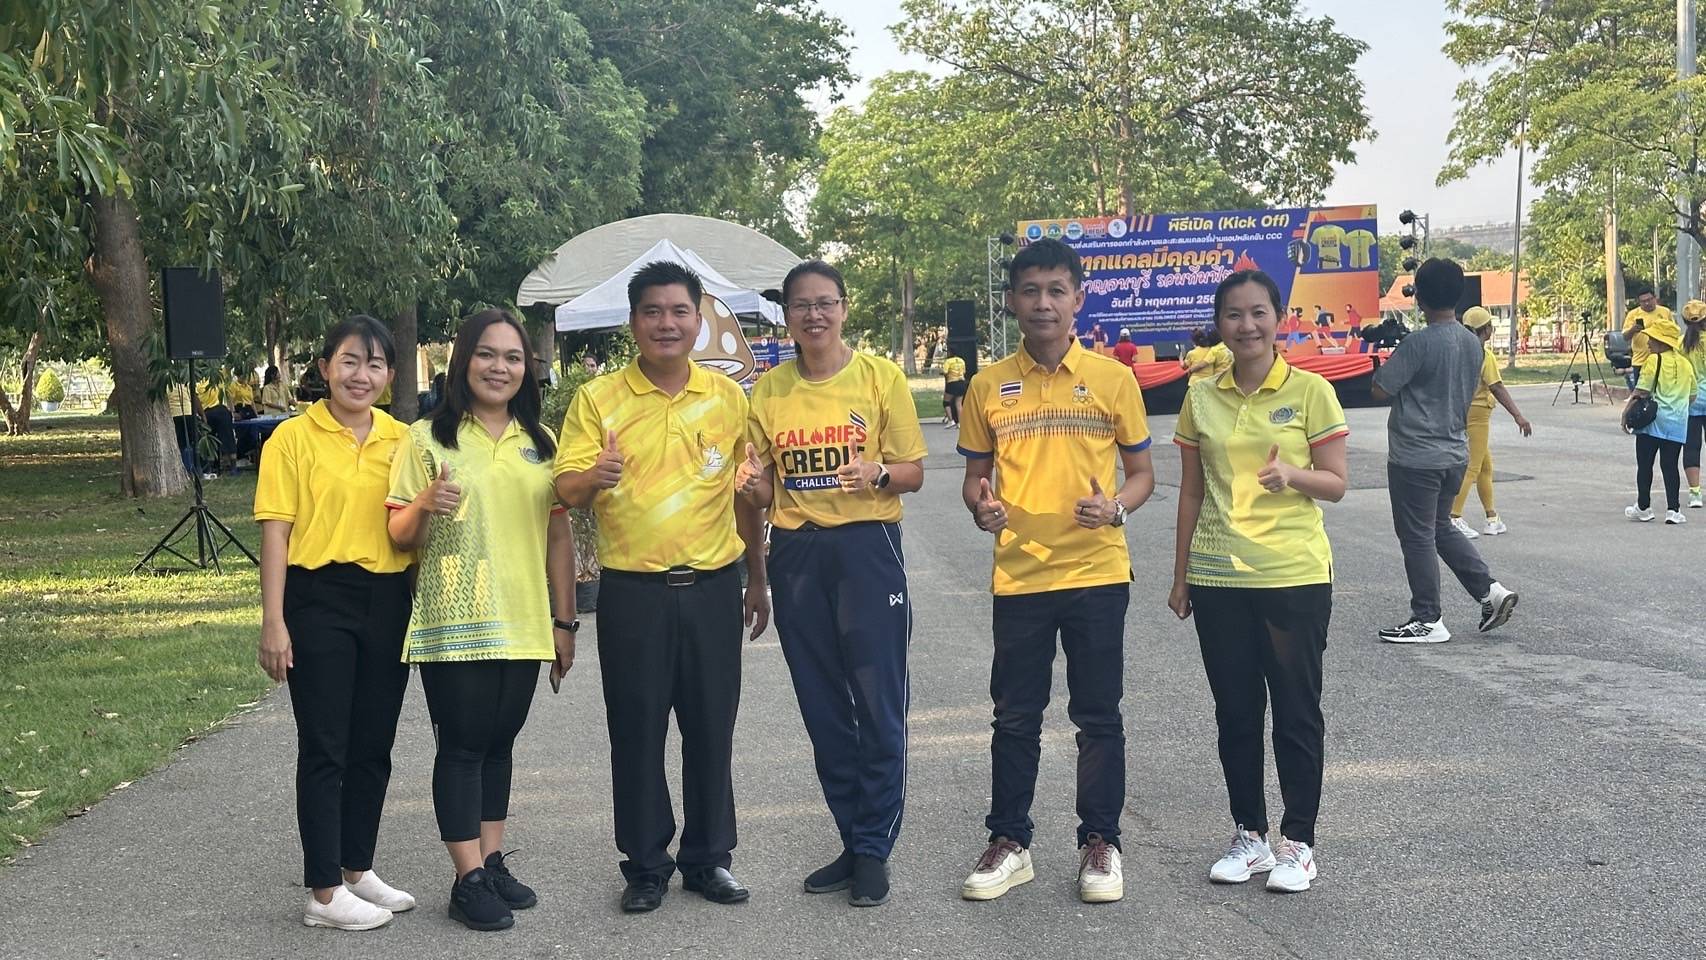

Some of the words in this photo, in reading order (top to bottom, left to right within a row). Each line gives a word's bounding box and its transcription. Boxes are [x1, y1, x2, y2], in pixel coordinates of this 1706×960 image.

[1168, 216, 1213, 231] พิธีเปิด
[1218, 216, 1257, 231] (Kick
[1261, 214, 1290, 228] Off)
[1081, 268, 1152, 297] าญจนบุรี
[1111, 294, 1133, 308] วันที่
[1135, 298, 1142, 307] 9
[1145, 296, 1194, 308] พฤษภาคม
[1196, 295, 1216, 305] 256
[795, 476, 842, 489] CHALLEN
